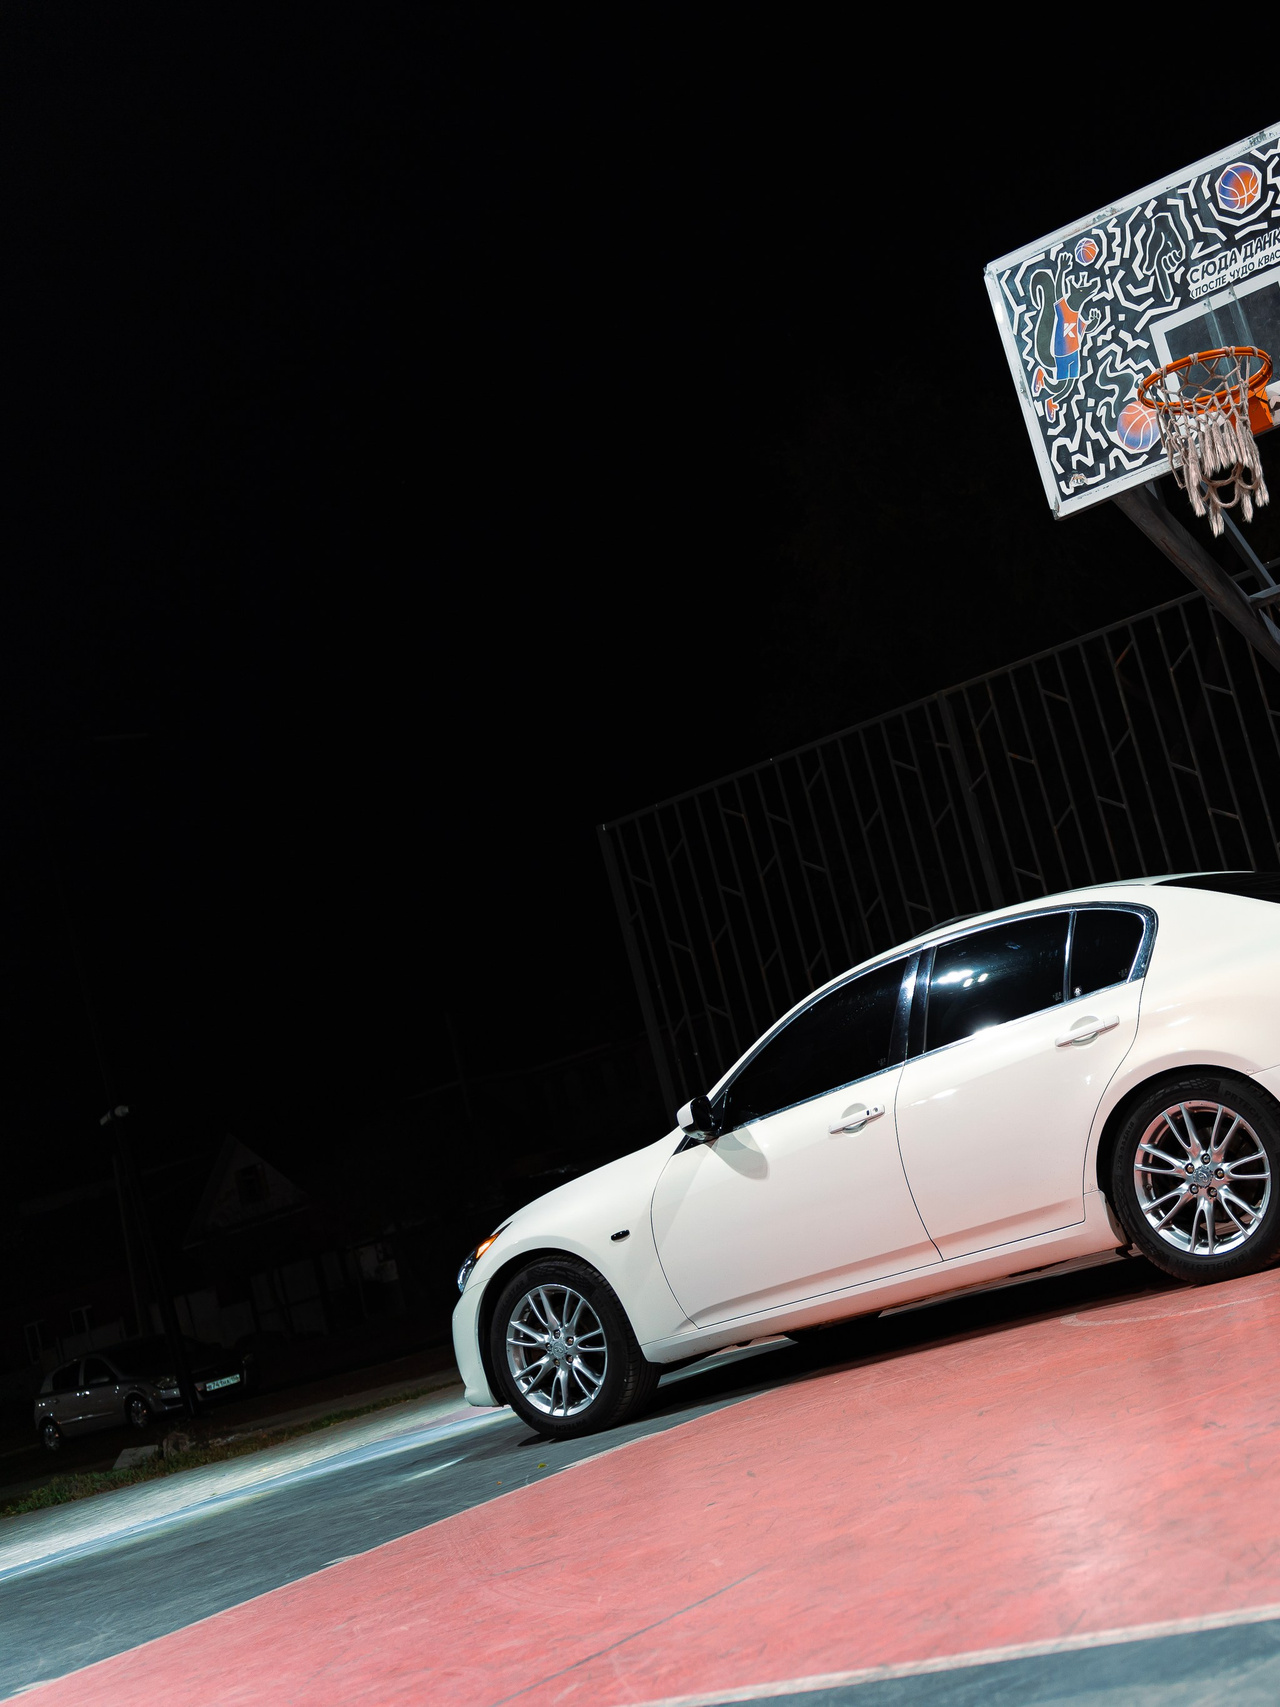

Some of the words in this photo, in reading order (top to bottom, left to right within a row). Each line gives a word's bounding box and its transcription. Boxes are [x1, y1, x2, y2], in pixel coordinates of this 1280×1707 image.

[1189, 250, 1238, 284] СЮДА
[1190, 276, 1227, 298] (ПОСЛЕ
[1229, 263, 1255, 280] ЧУДО
